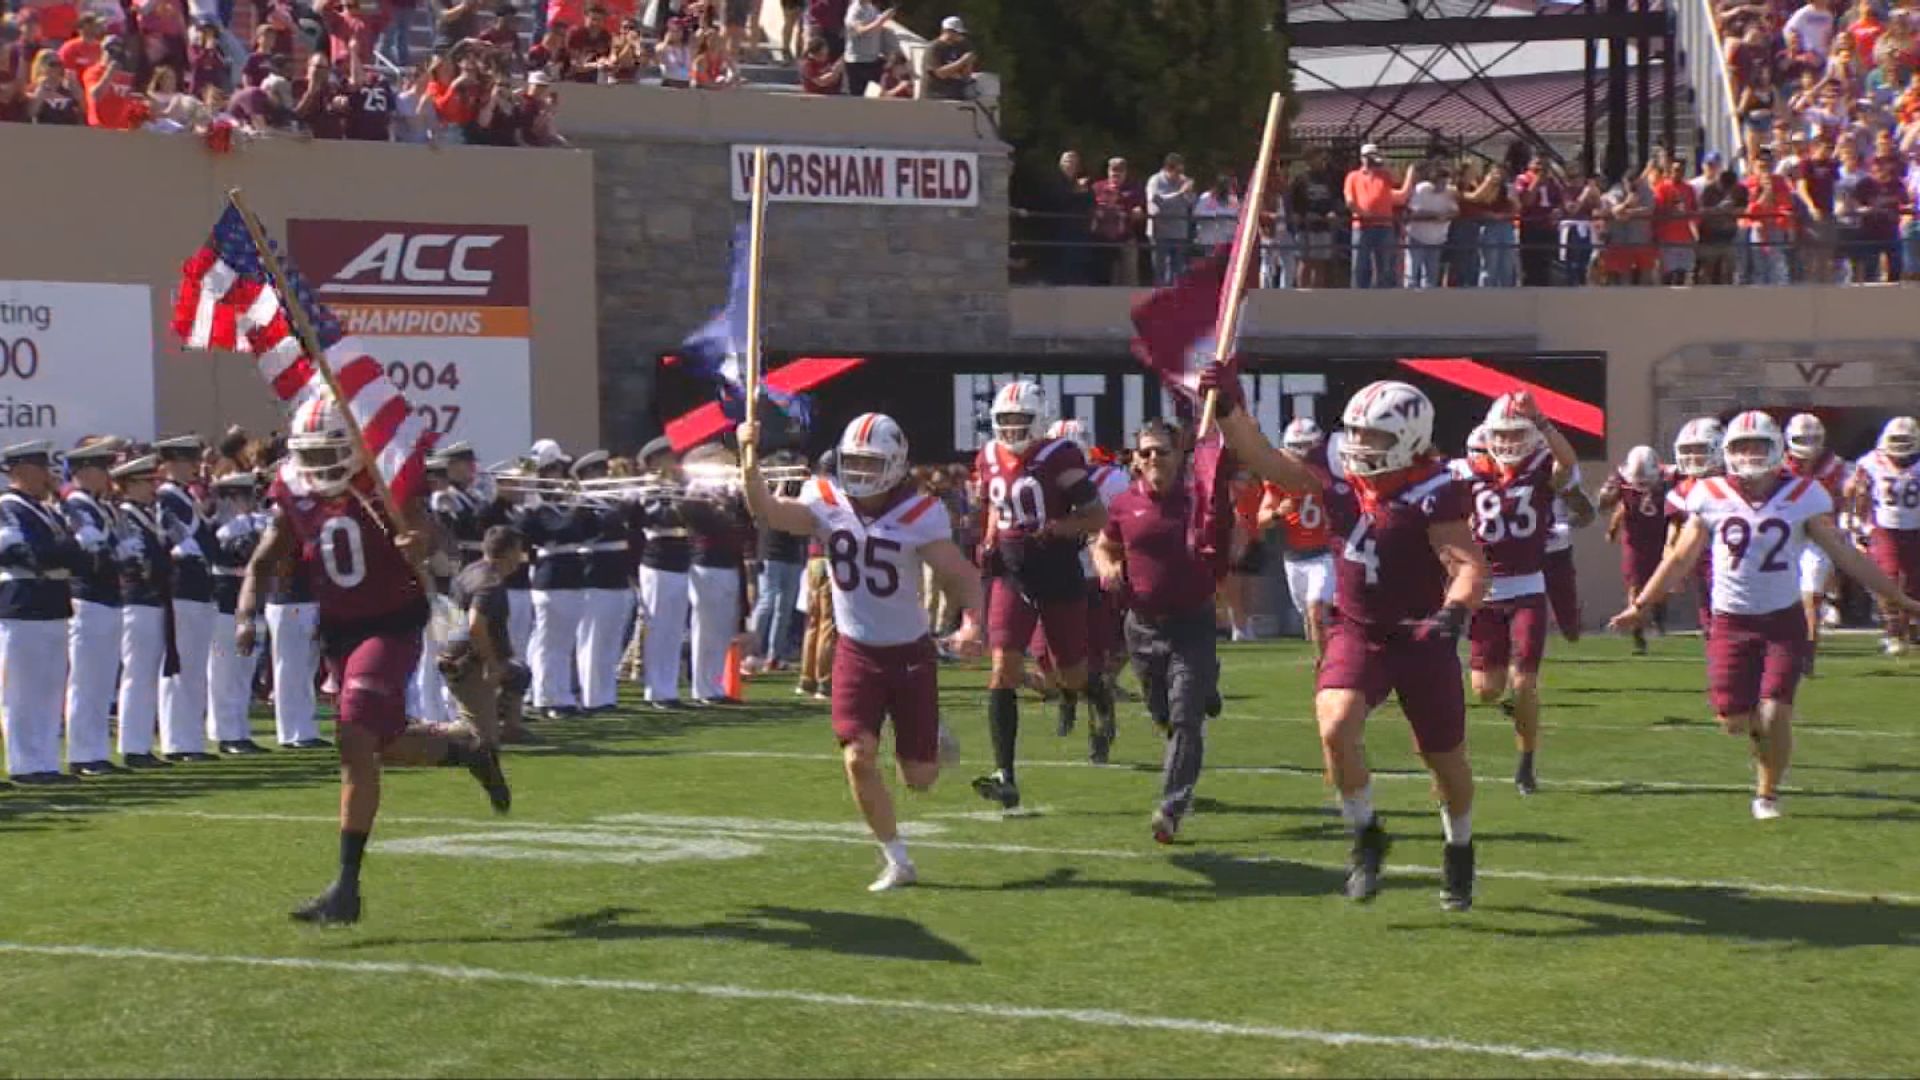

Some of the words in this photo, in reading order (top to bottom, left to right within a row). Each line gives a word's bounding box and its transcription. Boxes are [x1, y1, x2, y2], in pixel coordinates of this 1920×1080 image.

[361, 87, 387, 112] 25
[896, 157, 972, 199] FIELD
[333, 233, 504, 282] ACC
[379, 361, 460, 391] 004
[1796, 362, 1844, 387] VT
[988, 475, 1046, 531] 80
[1301, 494, 1321, 529] 6
[1474, 485, 1538, 544] 83
[321, 515, 366, 588] 0
[829, 529, 901, 598] 85
[1343, 513, 1381, 584] 4
[1720, 516, 1791, 573] 92
